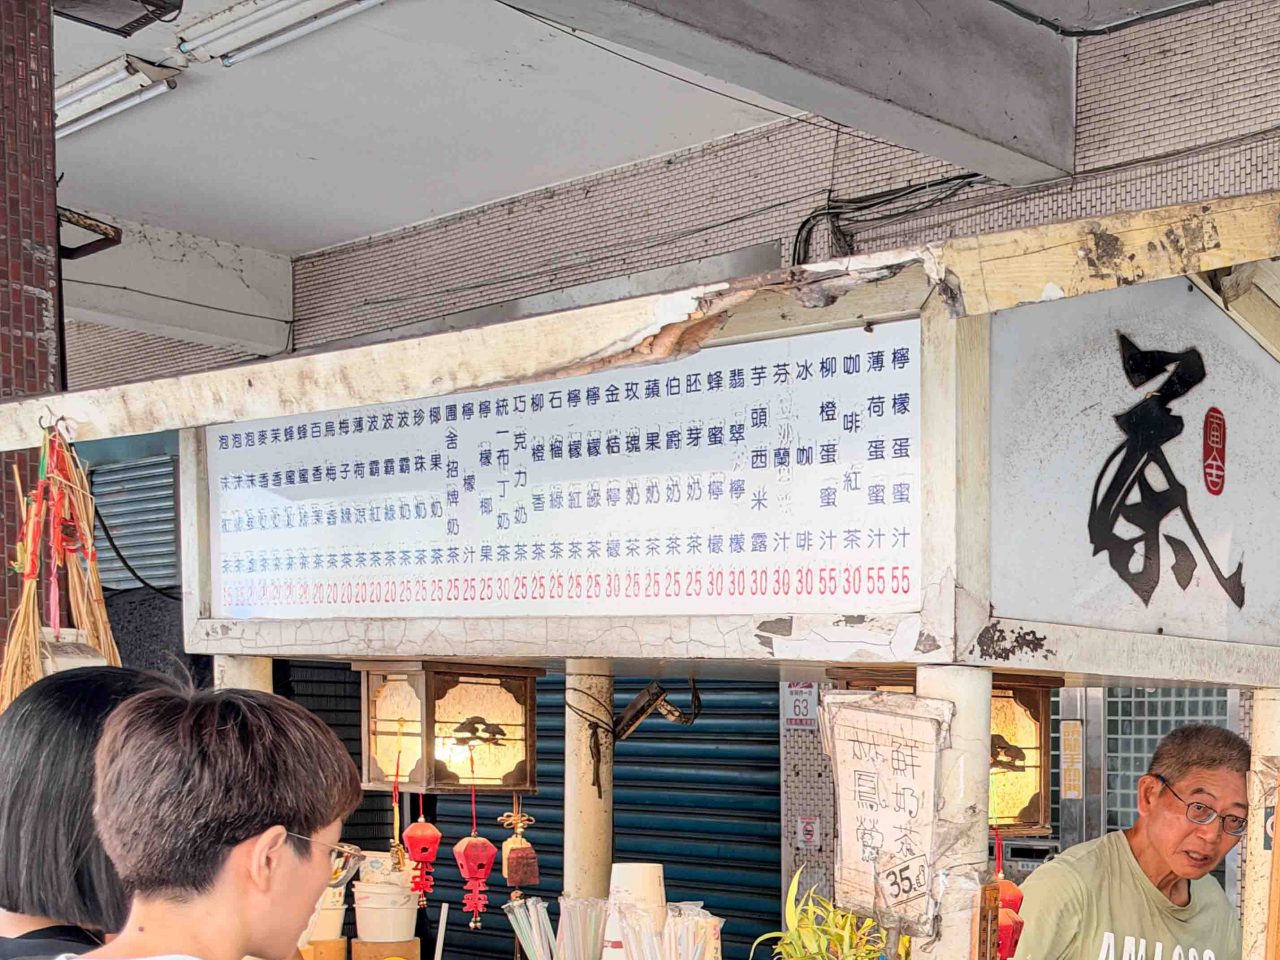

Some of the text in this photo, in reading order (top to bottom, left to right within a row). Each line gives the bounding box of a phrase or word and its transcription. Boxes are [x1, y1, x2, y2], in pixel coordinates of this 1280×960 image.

[397, 410, 412, 602] 波霸奶茶 25
[412, 408, 427, 602] 珍珠奶茶 25
[462, 402, 476, 601] 檸檬汁 25
[496, 398, 510, 600] 統一布丁奶茶 30
[512, 394, 528, 600] 巧克力奶茶 25
[530, 394, 546, 600] 柳橙香茶 25
[567, 389, 582, 599] 檸檬紅茶 25
[586, 386, 601, 599] 檸檬綠茶 25
[624, 382, 640, 598] 玫瑰奶茶 25
[644, 379, 660, 598] 蘋果奶茶 25
[665, 376, 680, 597] 伯爵奶茶 25
[686, 373, 702, 596] 胚芽奶茶 25
[707, 371, 724, 596] 蜂蜜檸檬 30
[728, 368, 745, 596] 翡翠檸檬 30
[750, 365, 768, 596] 芋頭西米露 30
[796, 360, 814, 595] 冰咖啡 30
[819, 357, 837, 595] 柳橙蛋蜜汁 55
[843, 354, 861, 595] 咖啡紅茶 30
[867, 350, 885, 594] 薄荷蛋蜜汁 55
[892, 348, 910, 594] 檸檬蛋蜜汁 55
[326, 583, 338, 604] 20
[340, 582, 352, 603] 20
[355, 582, 366, 603] 20
[370, 581, 381, 602] 20
[384, 581, 396, 602] 20
[431, 579, 444, 601] 25
[447, 578, 460, 601] 25
[480, 577, 493, 601] 25
[550, 576, 564, 599] 25
[606, 574, 620, 598] 30
[773, 569, 790, 595] 30
[793, 698, 809, 717] 63
